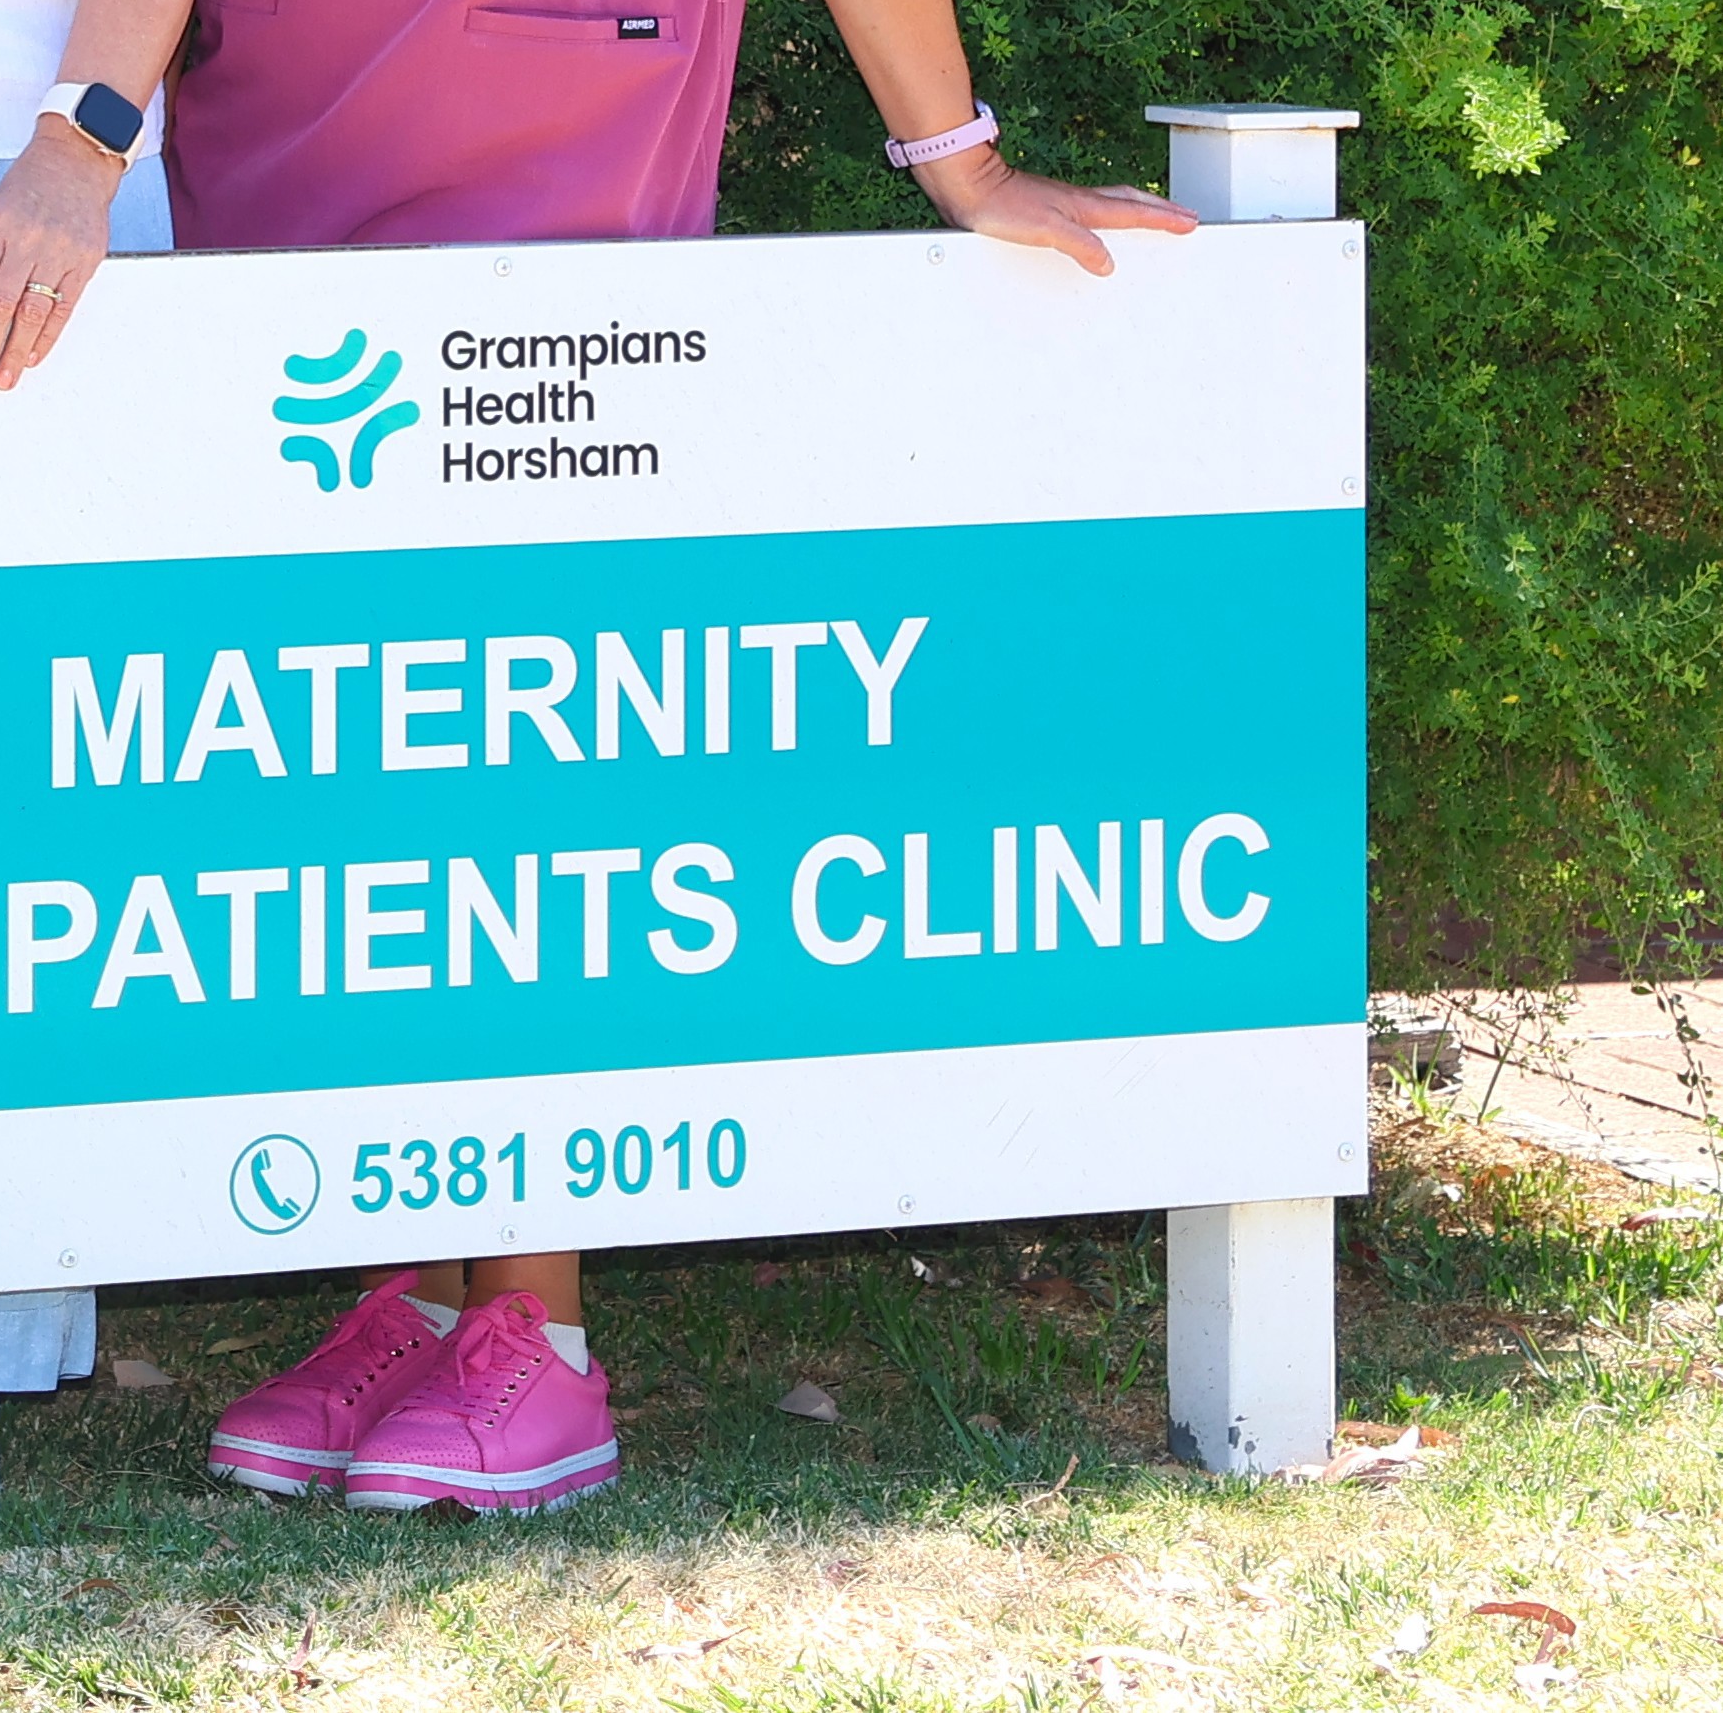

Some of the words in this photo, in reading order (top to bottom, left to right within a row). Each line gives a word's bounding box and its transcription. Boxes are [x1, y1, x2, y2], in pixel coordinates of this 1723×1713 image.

[441, 320, 706, 381] Grampians
[443, 380, 595, 427] Health
[443, 436, 659, 483] Horsham
[51, 616, 930, 789] MATERNITY
[791, 812, 1271, 966] CLINIC
[351, 1132, 526, 1214] 5381
[564, 1117, 747, 1199] 9010
